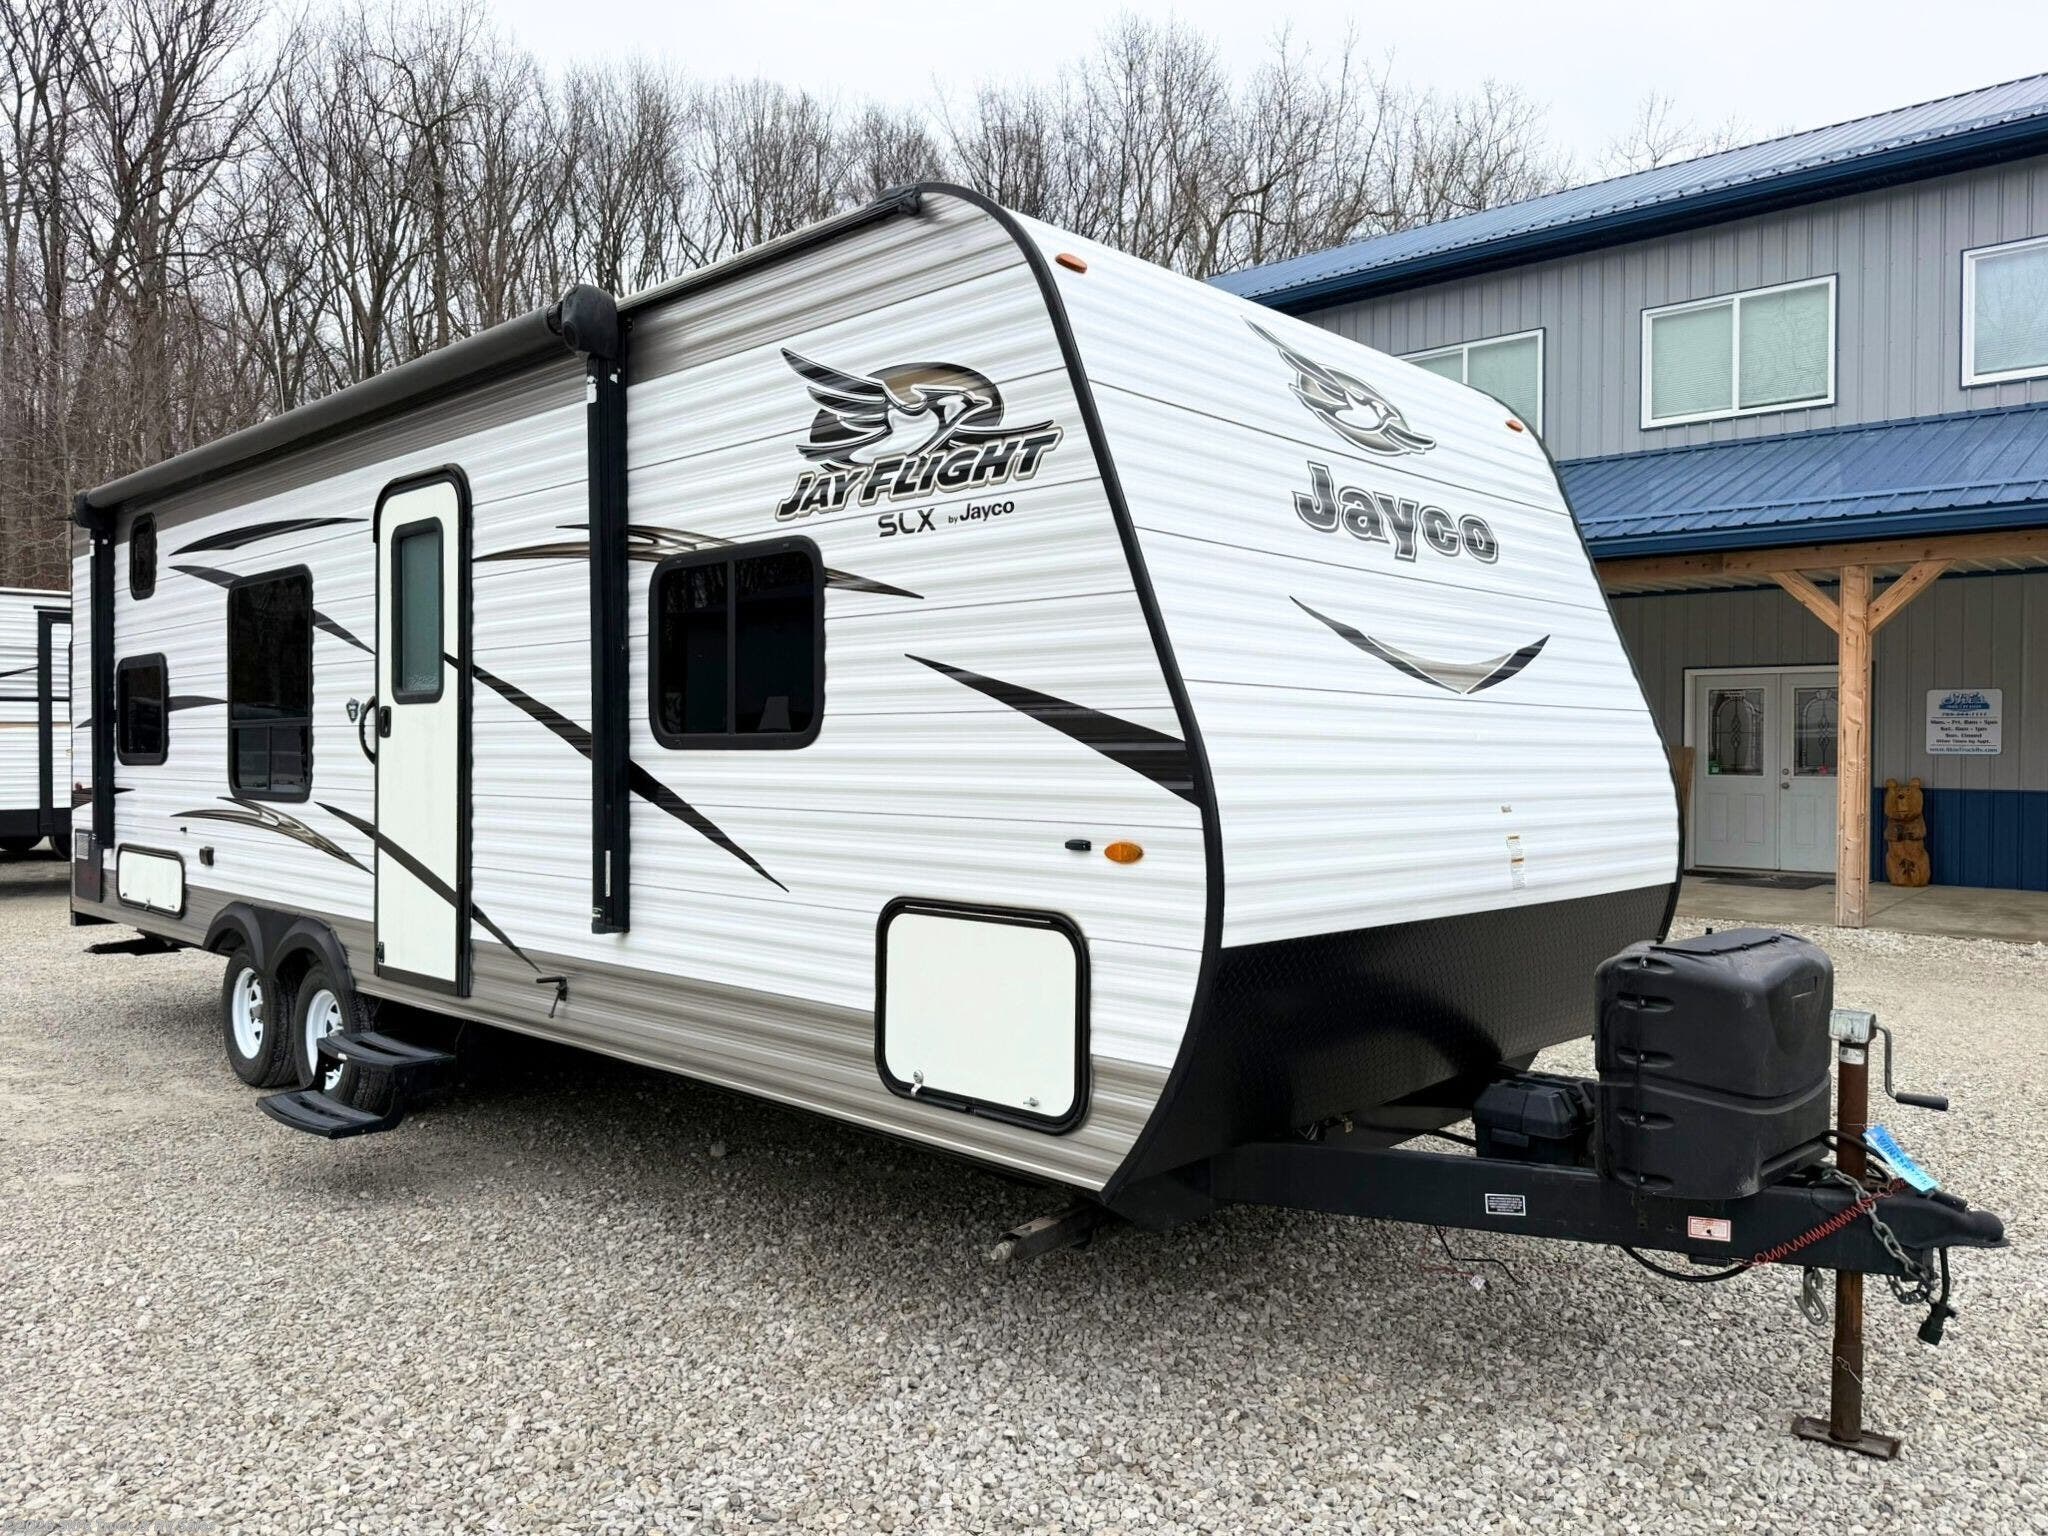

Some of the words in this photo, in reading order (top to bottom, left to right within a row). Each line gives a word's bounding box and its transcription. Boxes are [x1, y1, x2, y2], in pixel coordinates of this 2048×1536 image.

[878, 507, 937, 538] SLX
[948, 515, 959, 524] by
[959, 500, 1015, 522] Jayco
[1292, 461, 1499, 564] Jayco
